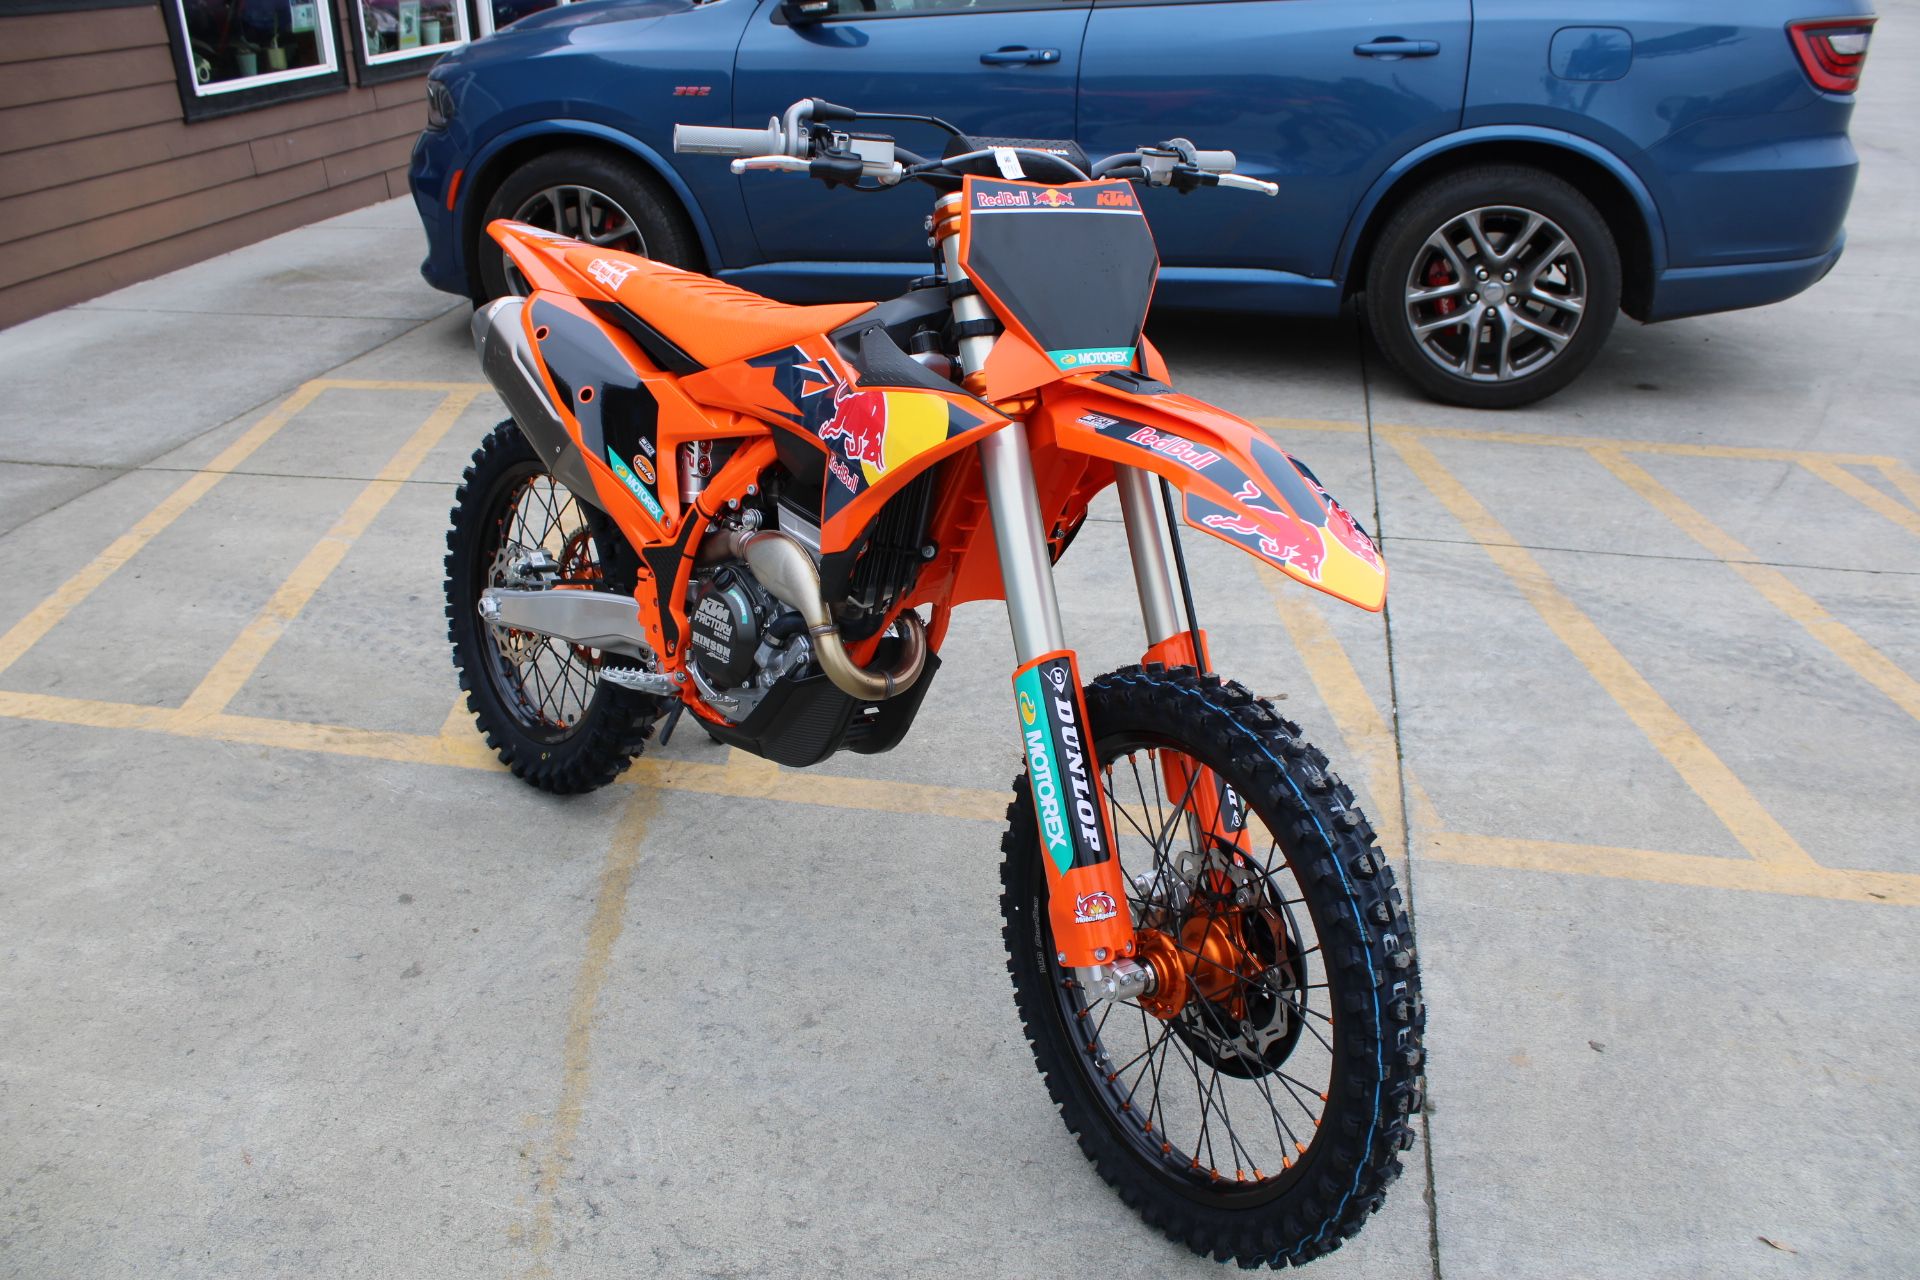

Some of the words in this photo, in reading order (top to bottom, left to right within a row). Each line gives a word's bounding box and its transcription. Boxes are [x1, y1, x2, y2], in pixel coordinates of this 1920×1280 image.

[1097, 190, 1133, 207] KTM
[1077, 351, 1129, 364] MOTOREX
[1126, 426, 1175, 452] Red
[1165, 436, 1222, 471] Bull
[625, 473, 660, 519] MOTOREX
[699, 597, 730, 622] KTM
[694, 610, 733, 637] FACTORY
[692, 631, 731, 657] HINSON
[1055, 696, 1101, 852] DUNLOP
[1026, 730, 1067, 850] MOTOREX
